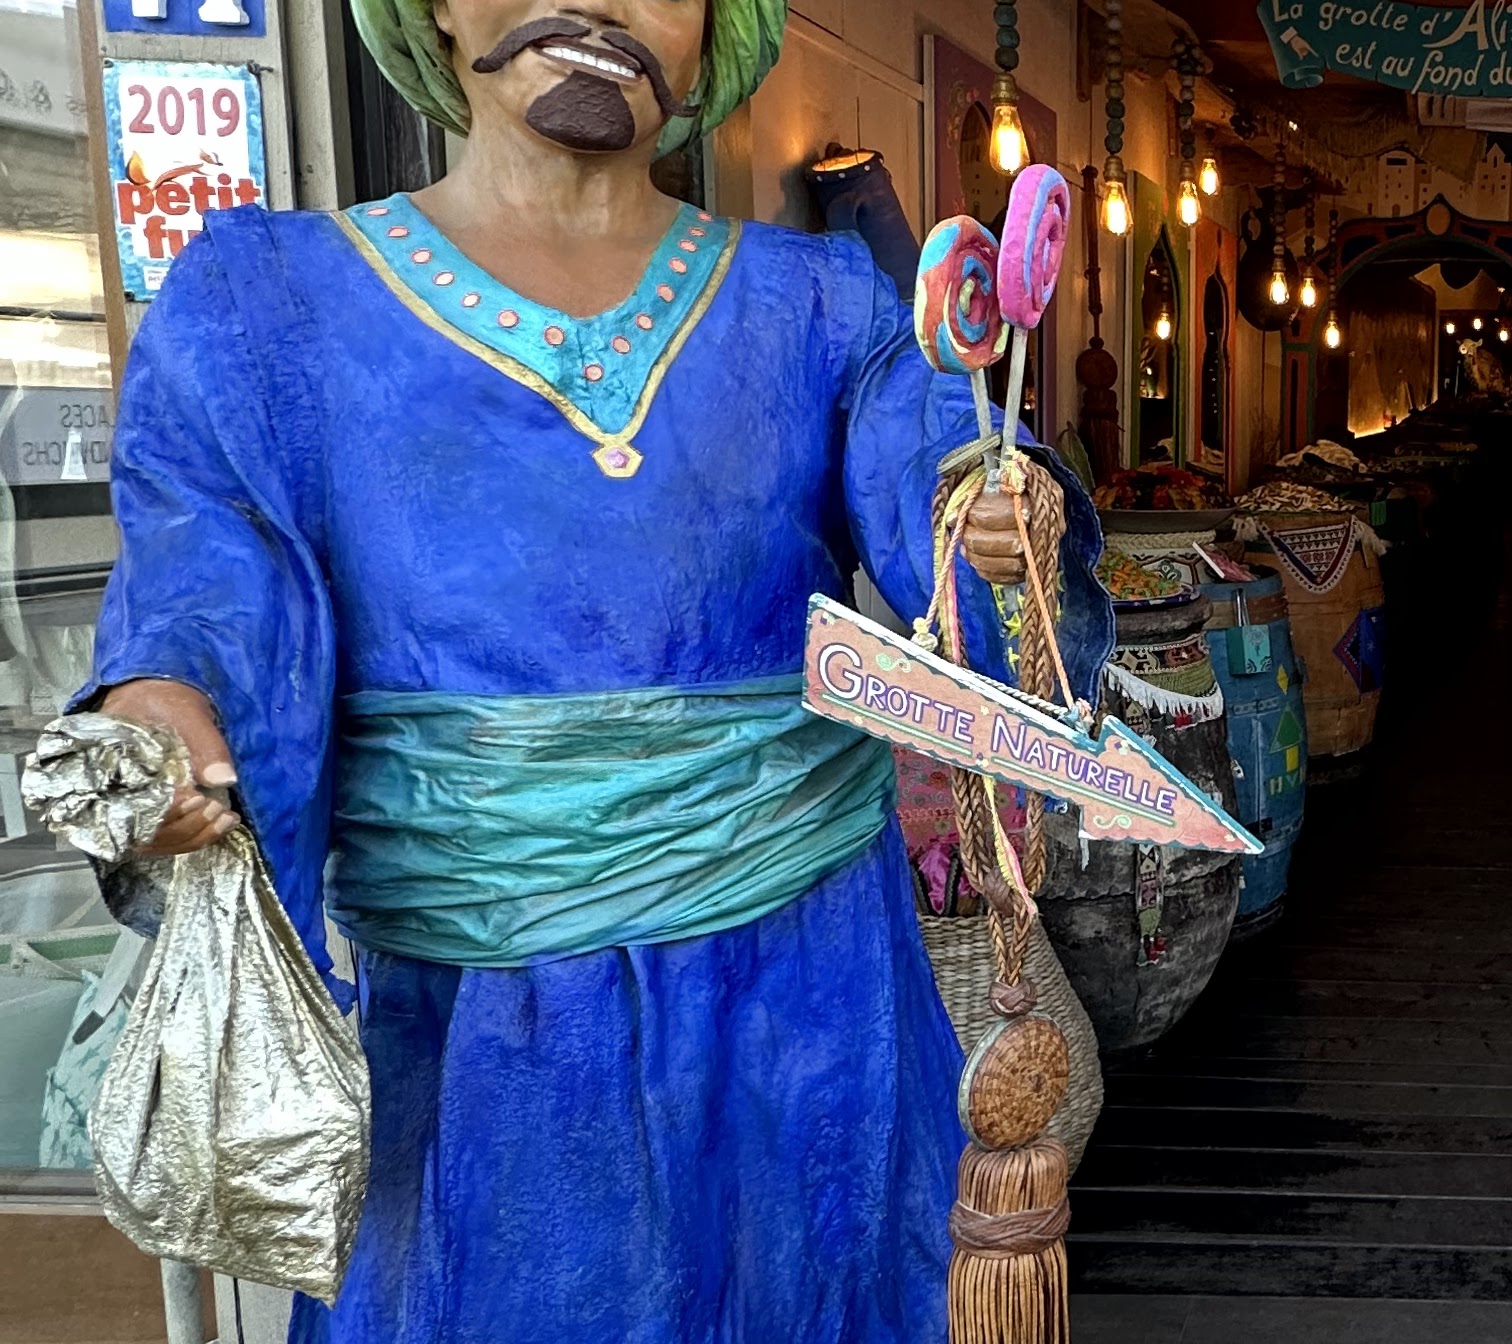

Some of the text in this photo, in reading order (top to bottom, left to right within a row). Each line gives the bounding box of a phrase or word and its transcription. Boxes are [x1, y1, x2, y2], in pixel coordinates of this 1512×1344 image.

[1318, 1, 1409, 31] grotte
[1335, 41, 1377, 69] est
[1381, 56, 1415, 77] au
[1410, 49, 1485, 95] fond
[127, 84, 241, 137] 2019
[117, 173, 262, 225] petit
[817, 643, 1179, 816] GROTTE NATURELLE
